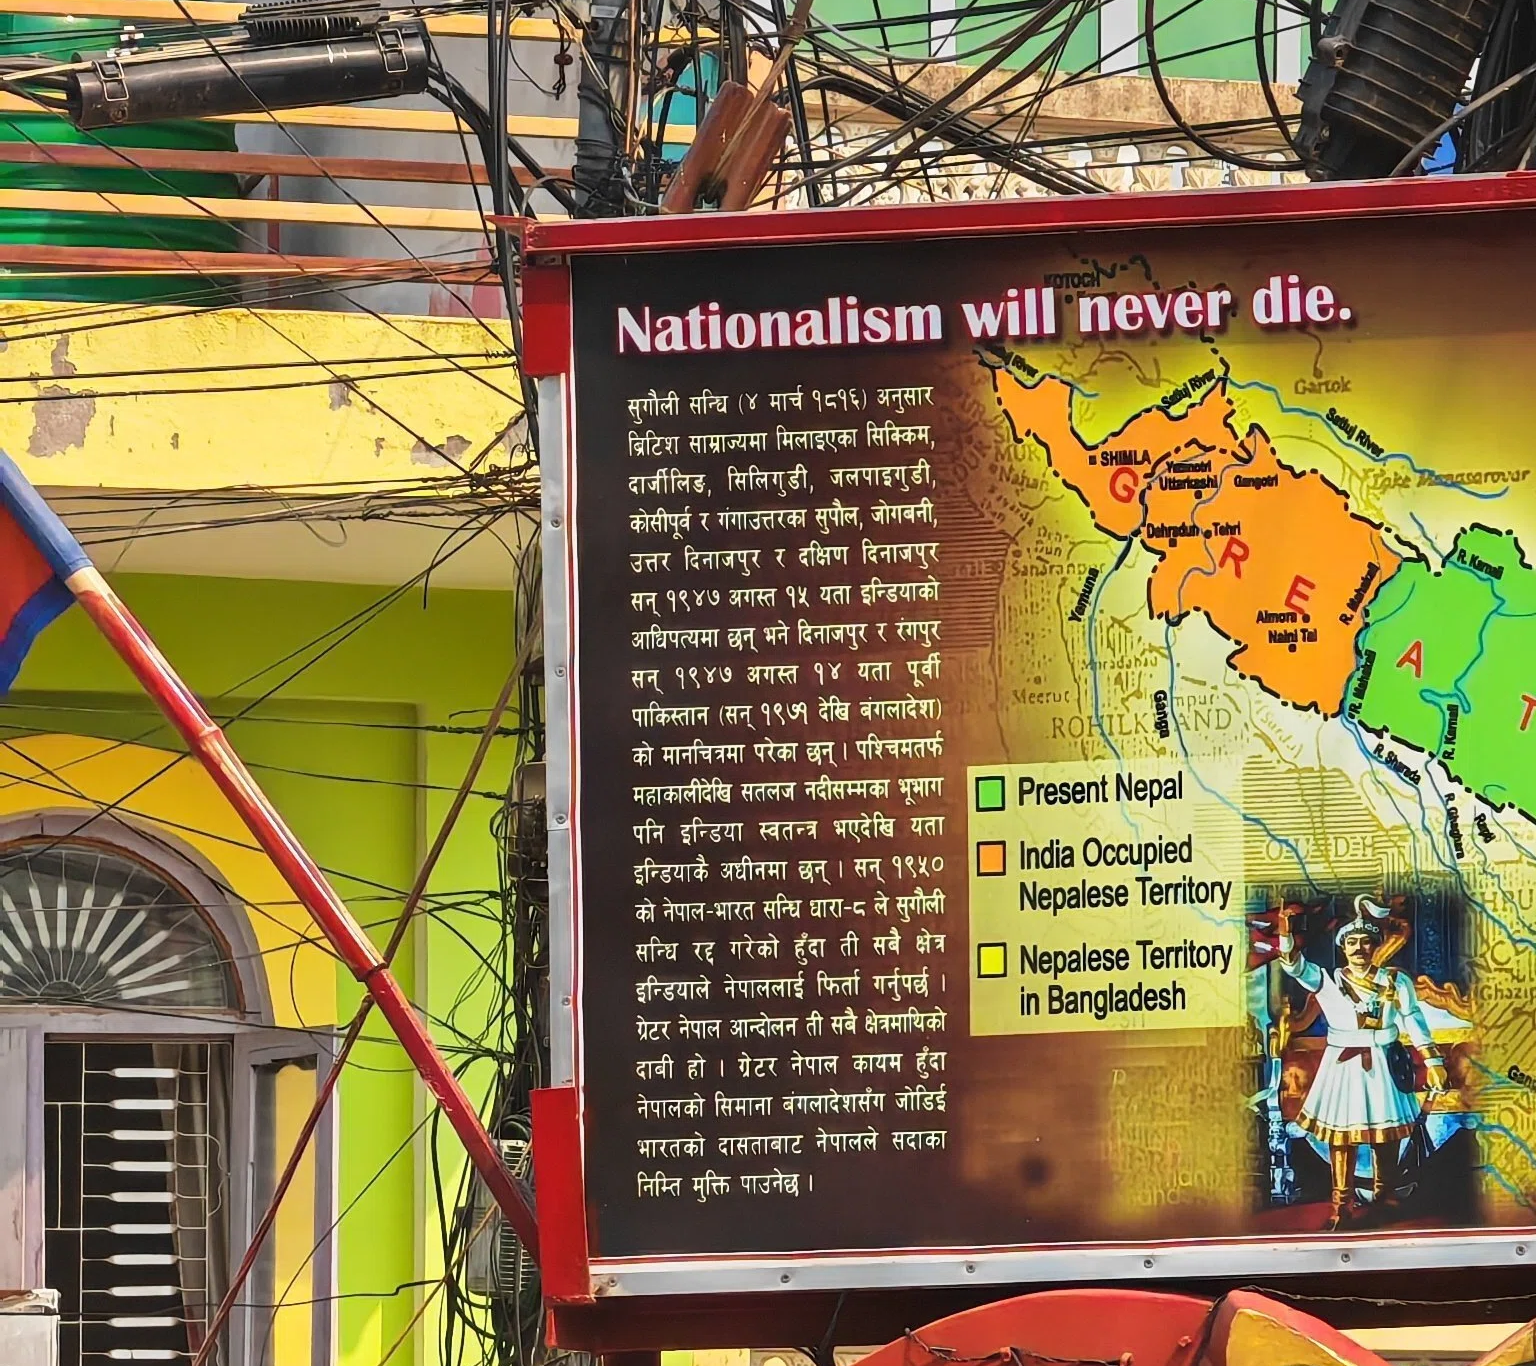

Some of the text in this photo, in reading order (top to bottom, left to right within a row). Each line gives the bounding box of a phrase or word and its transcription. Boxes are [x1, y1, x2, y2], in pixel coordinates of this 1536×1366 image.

[617, 274, 1353, 353] Nationalism will never die.
[627, 388, 680, 425] सुगौली
[768, 384, 804, 412] मार्च
[812, 387, 866, 412] १८१६)
[877, 387, 934, 414] अनुसार
[629, 419, 934, 457] ब्रिटिश साम्राज्यमा मिलाइएका सिक्किम,
[728, 463, 813, 498] सिलिगुडी,
[829, 458, 935, 492] जलपाइगुडी,
[1100, 450, 1151, 467] SHIMLA
[629, 506, 692, 539] कोसीपूर्व
[699, 512, 710, 531] र
[815, 498, 863, 534] सुपौल,
[871, 497, 937, 528] जोगबनी,
[629, 538, 940, 577] उत्तर दिनाजपुर र दक्षिण दिनाजपुर
[630, 575, 941, 618] सन् १९४७ अगस्त १५ यता इन्डियाको
[728, 627, 758, 654] छन्
[763, 620, 790, 646] भने
[798, 618, 868, 650] दिनाजपुर
[876, 622, 888, 642] र
[895, 617, 941, 648] रंगपुर
[632, 774, 944, 806] महाकालीदेखि सतलज नदीसम्मका भूभाग
[1018, 770, 1184, 808] Present Nepal
[1019, 833, 1193, 872] India Occupied
[1019, 874, 1233, 917] Nepalese Territory
[729, 932, 780, 960] गरेको
[840, 930, 859, 957] ती
[872, 927, 901, 956] सबै
[916, 928, 946, 955] क्षेत्र
[1020, 938, 1234, 980] Nepalese Territory
[1020, 980, 1187, 1021] in Bangladesh
[637, 1093, 706, 1119] नेपालको
[715, 1091, 773, 1118] सिमाना
[637, 1126, 947, 1158] भारतको दासताबाट नेपालले सदाका
